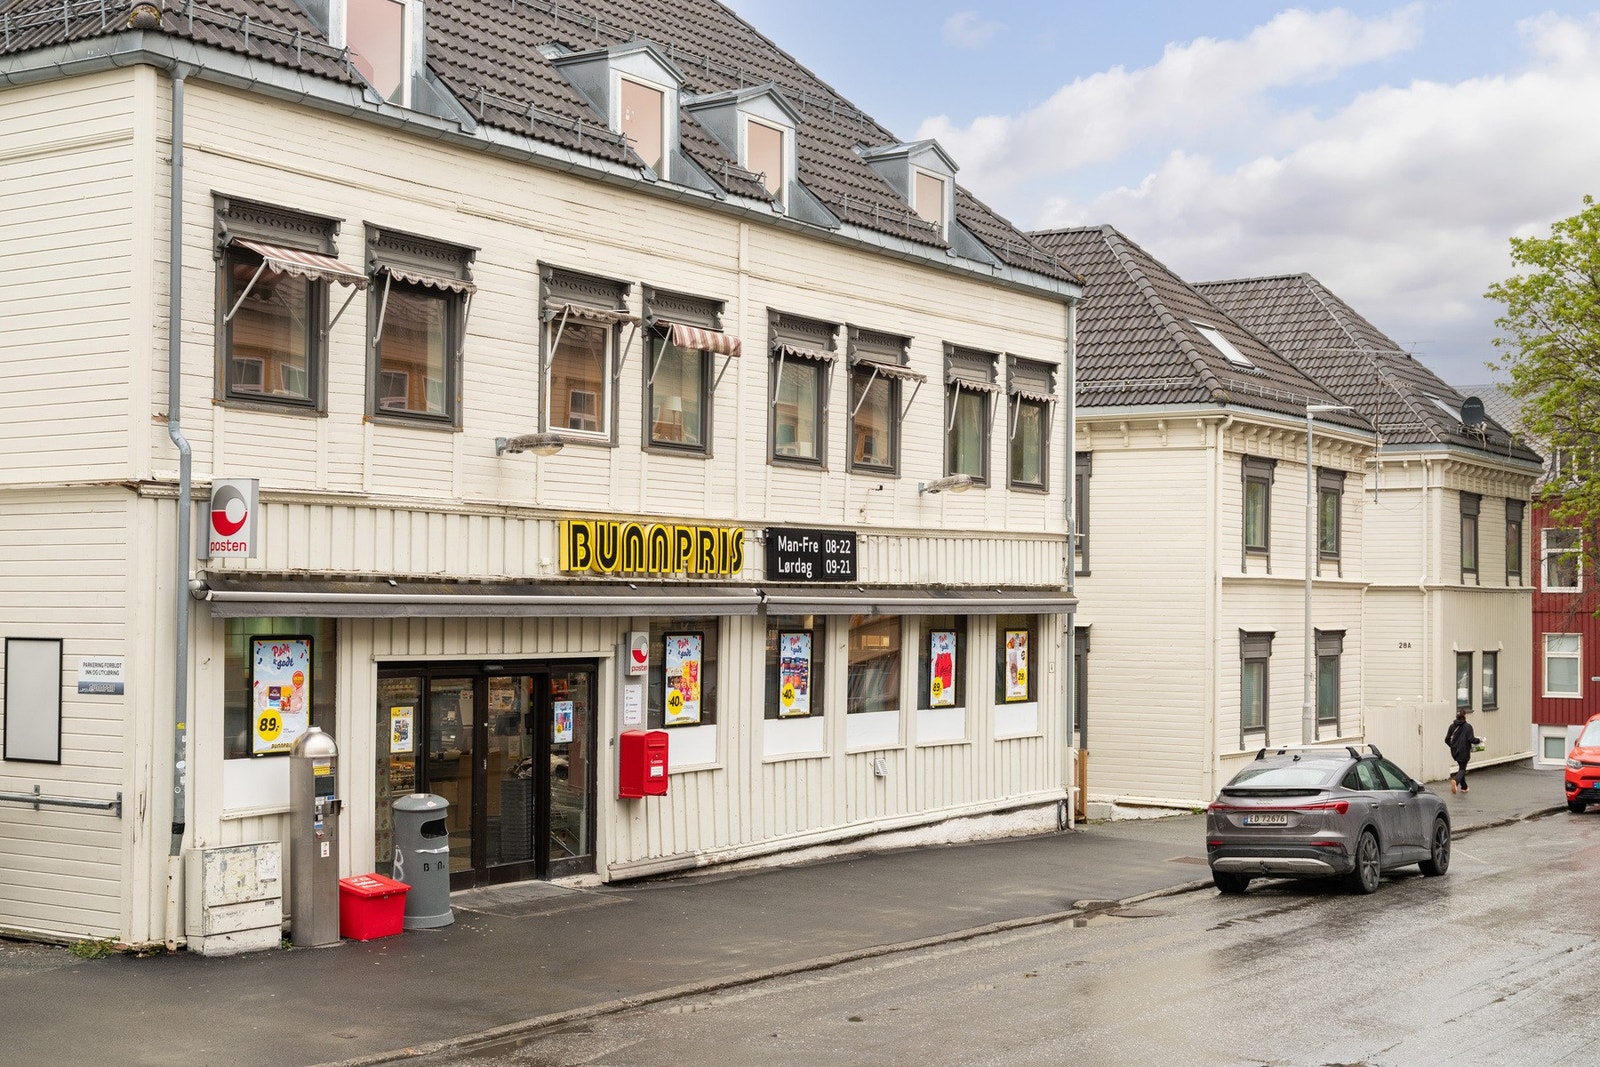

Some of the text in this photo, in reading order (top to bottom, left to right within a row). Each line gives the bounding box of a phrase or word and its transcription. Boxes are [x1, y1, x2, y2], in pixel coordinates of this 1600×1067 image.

[210, 540, 247, 553] posten
[562, 520, 745, 575] BUNNPRIS
[778, 535, 851, 554] Man-Fre 08-22
[778, 556, 851, 578] Lørdag 09-21
[277, 656, 294, 670] godt
[1262, 814, 1285, 822] 72676
